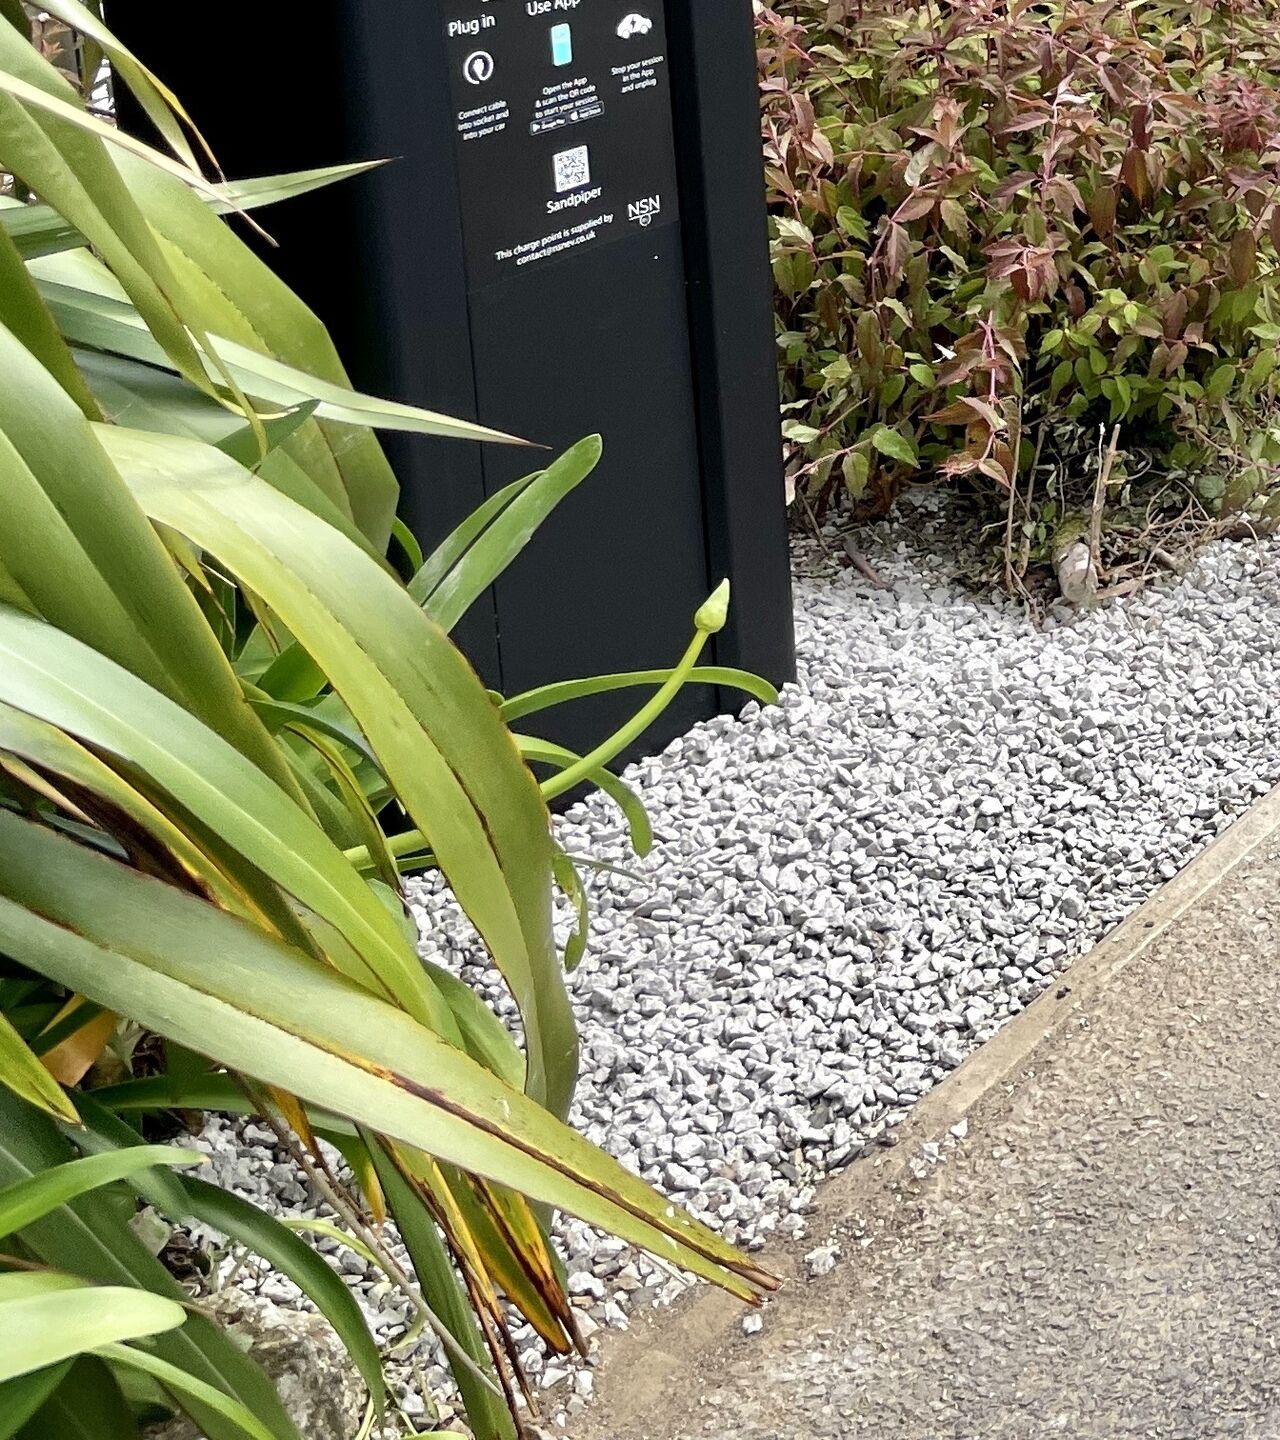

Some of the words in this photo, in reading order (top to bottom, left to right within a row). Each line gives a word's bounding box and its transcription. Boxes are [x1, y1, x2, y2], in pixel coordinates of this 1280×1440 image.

[526, 0, 551, 16] Use
[448, 19, 480, 37] Plug
[481, 14, 496, 29] in
[611, 66, 626, 76] Stop
[626, 61, 641, 72] your
[641, 55, 664, 67] session
[629, 72, 641, 80] the
[641, 69, 655, 77] App
[542, 85, 562, 95] Open
[561, 81, 573, 90] the
[573, 77, 588, 86] App
[542, 96, 557, 106] scan
[557, 93, 569, 101] the
[568, 88, 579, 98] QR
[579, 84, 596, 95] code
[621, 83, 634, 93] and
[634, 78, 657, 89] unplug
[458, 105, 487, 120] Connect
[487, 100, 507, 111] cable
[535, 111, 544, 119] to
[543, 106, 559, 116] start
[559, 102, 574, 112] your
[574, 95, 599, 107] session
[473, 115, 495, 127] socket
[495, 109, 510, 120] and
[478, 126, 494, 138] your
[494, 122, 506, 132] car
[546, 186, 602, 214] Sandpiper
[627, 194, 660, 218] NSN
[494, 248, 513, 261] This
[513, 239, 541, 256] charge
[541, 231, 562, 247] point
[563, 228, 570, 237] is
[570, 215, 603, 235] supplied
[603, 213, 614, 224] by
